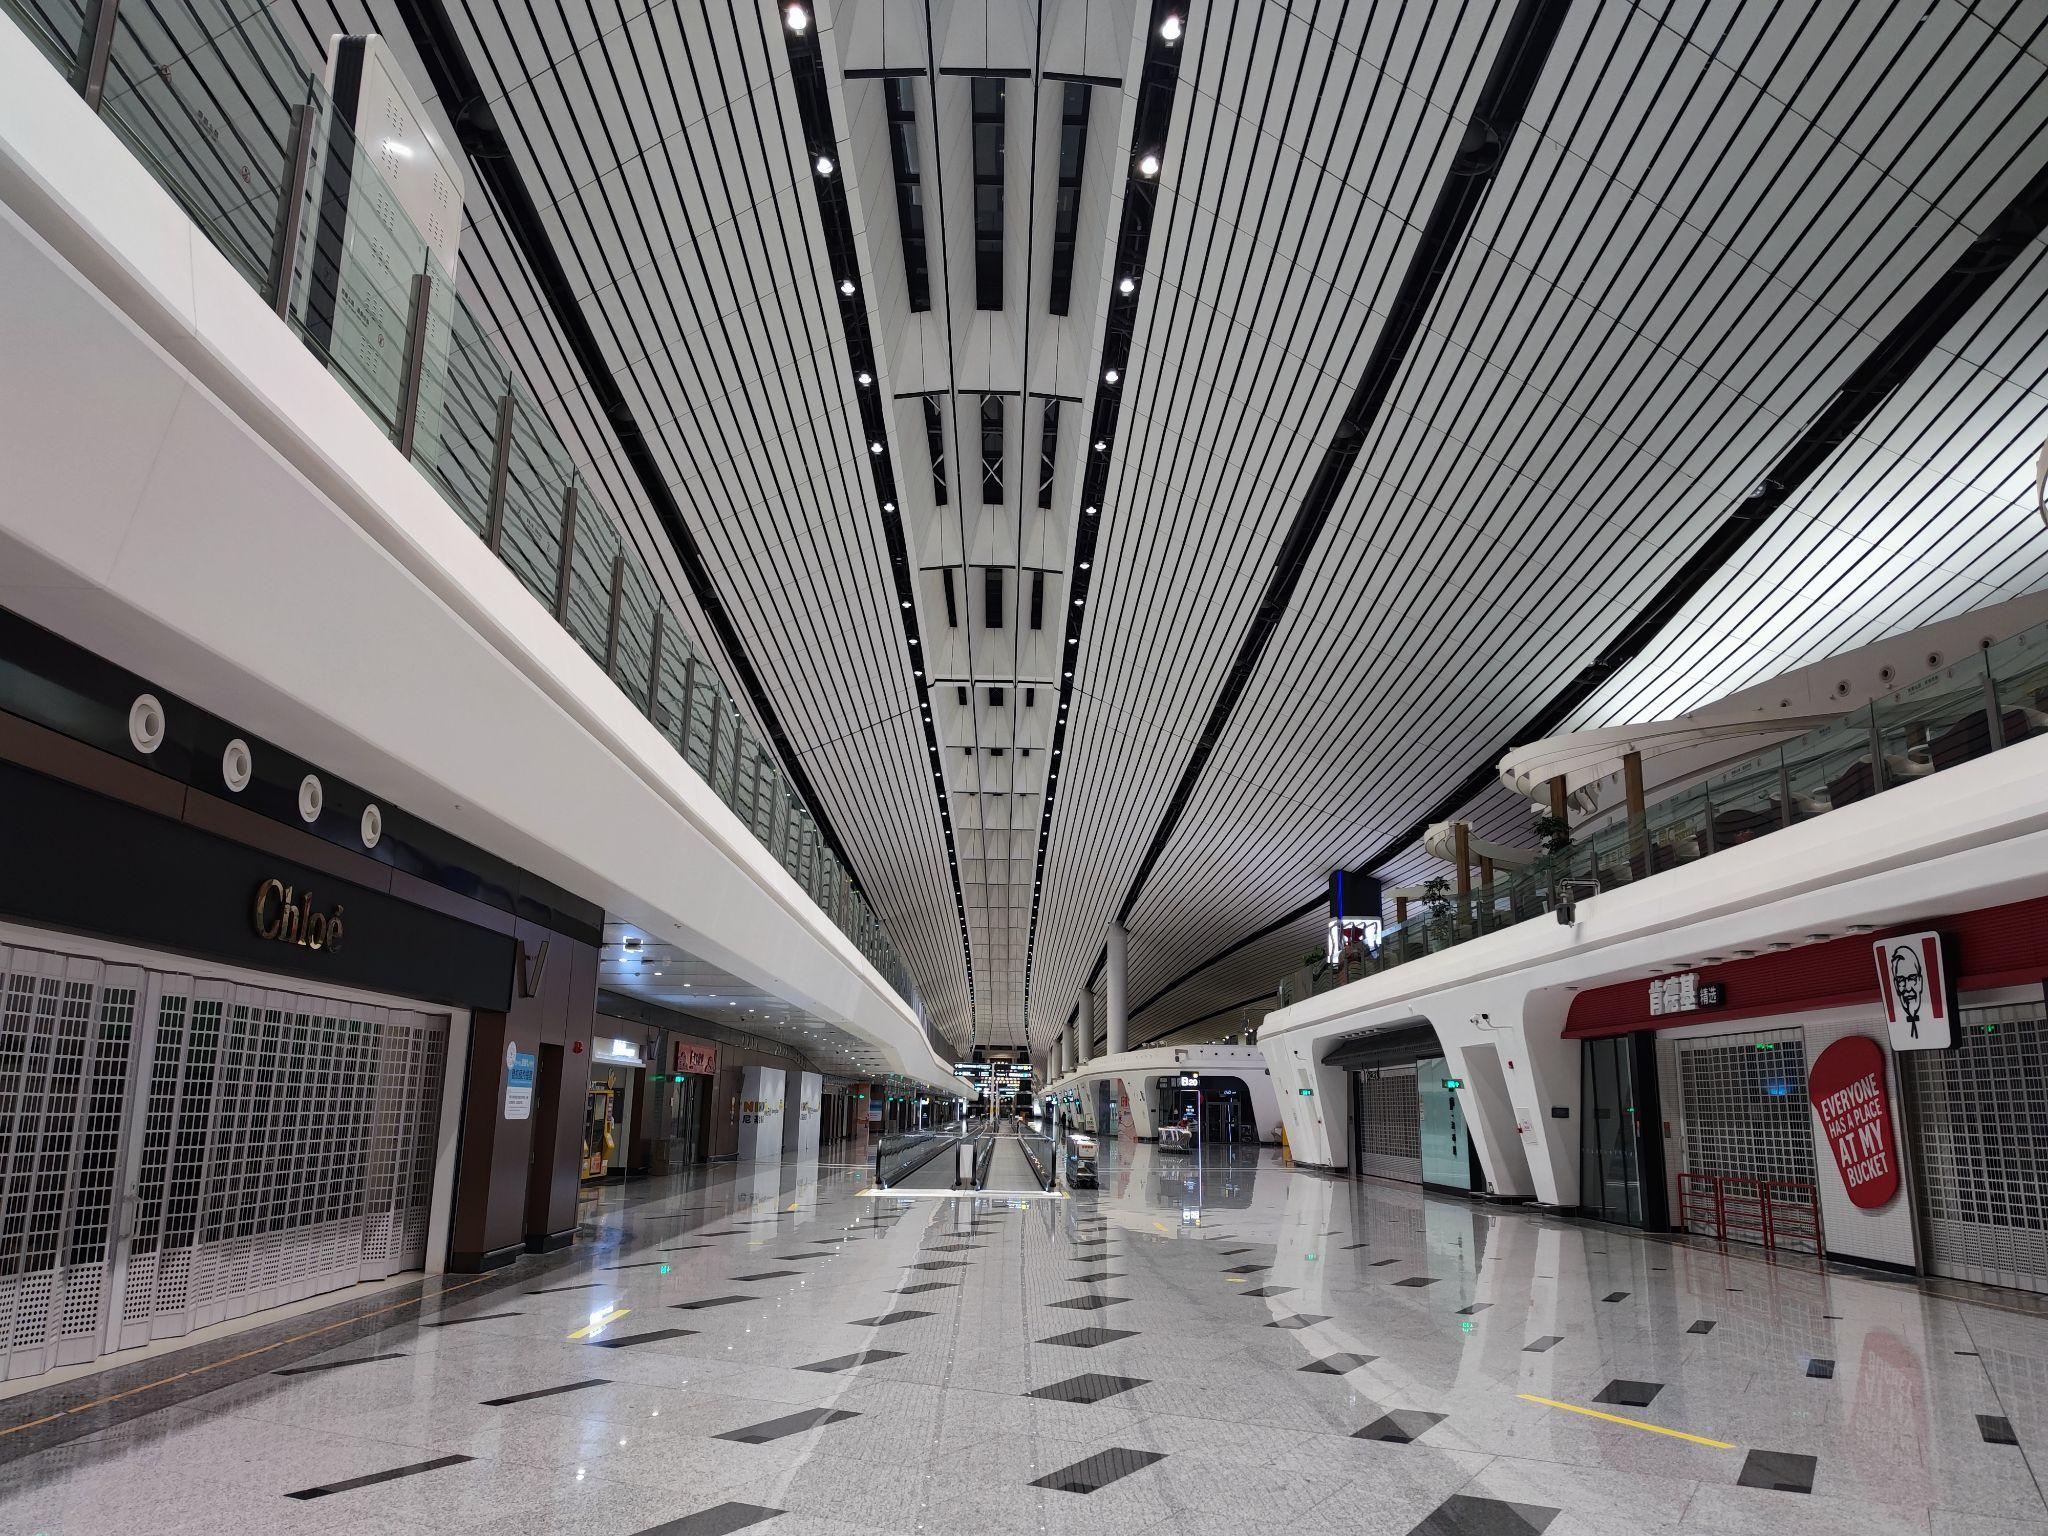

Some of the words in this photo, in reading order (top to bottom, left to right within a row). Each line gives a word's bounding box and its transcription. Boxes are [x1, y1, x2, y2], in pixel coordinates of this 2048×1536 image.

[256, 879, 344, 954] Chloé
[1649, 973, 1699, 1016] 肯德基
[1700, 986, 1717, 1006] 精选
[1820, 1072, 1880, 1122] EVERYONE
[1828, 1116, 1847, 1139] HAS
[1847, 1112, 1855, 1130] A
[1854, 1098, 1882, 1125] PLACE
[1838, 1132, 1858, 1168] AT
[1858, 1119, 1884, 1158] MY
[1846, 1151, 1888, 1188] BUCKET
